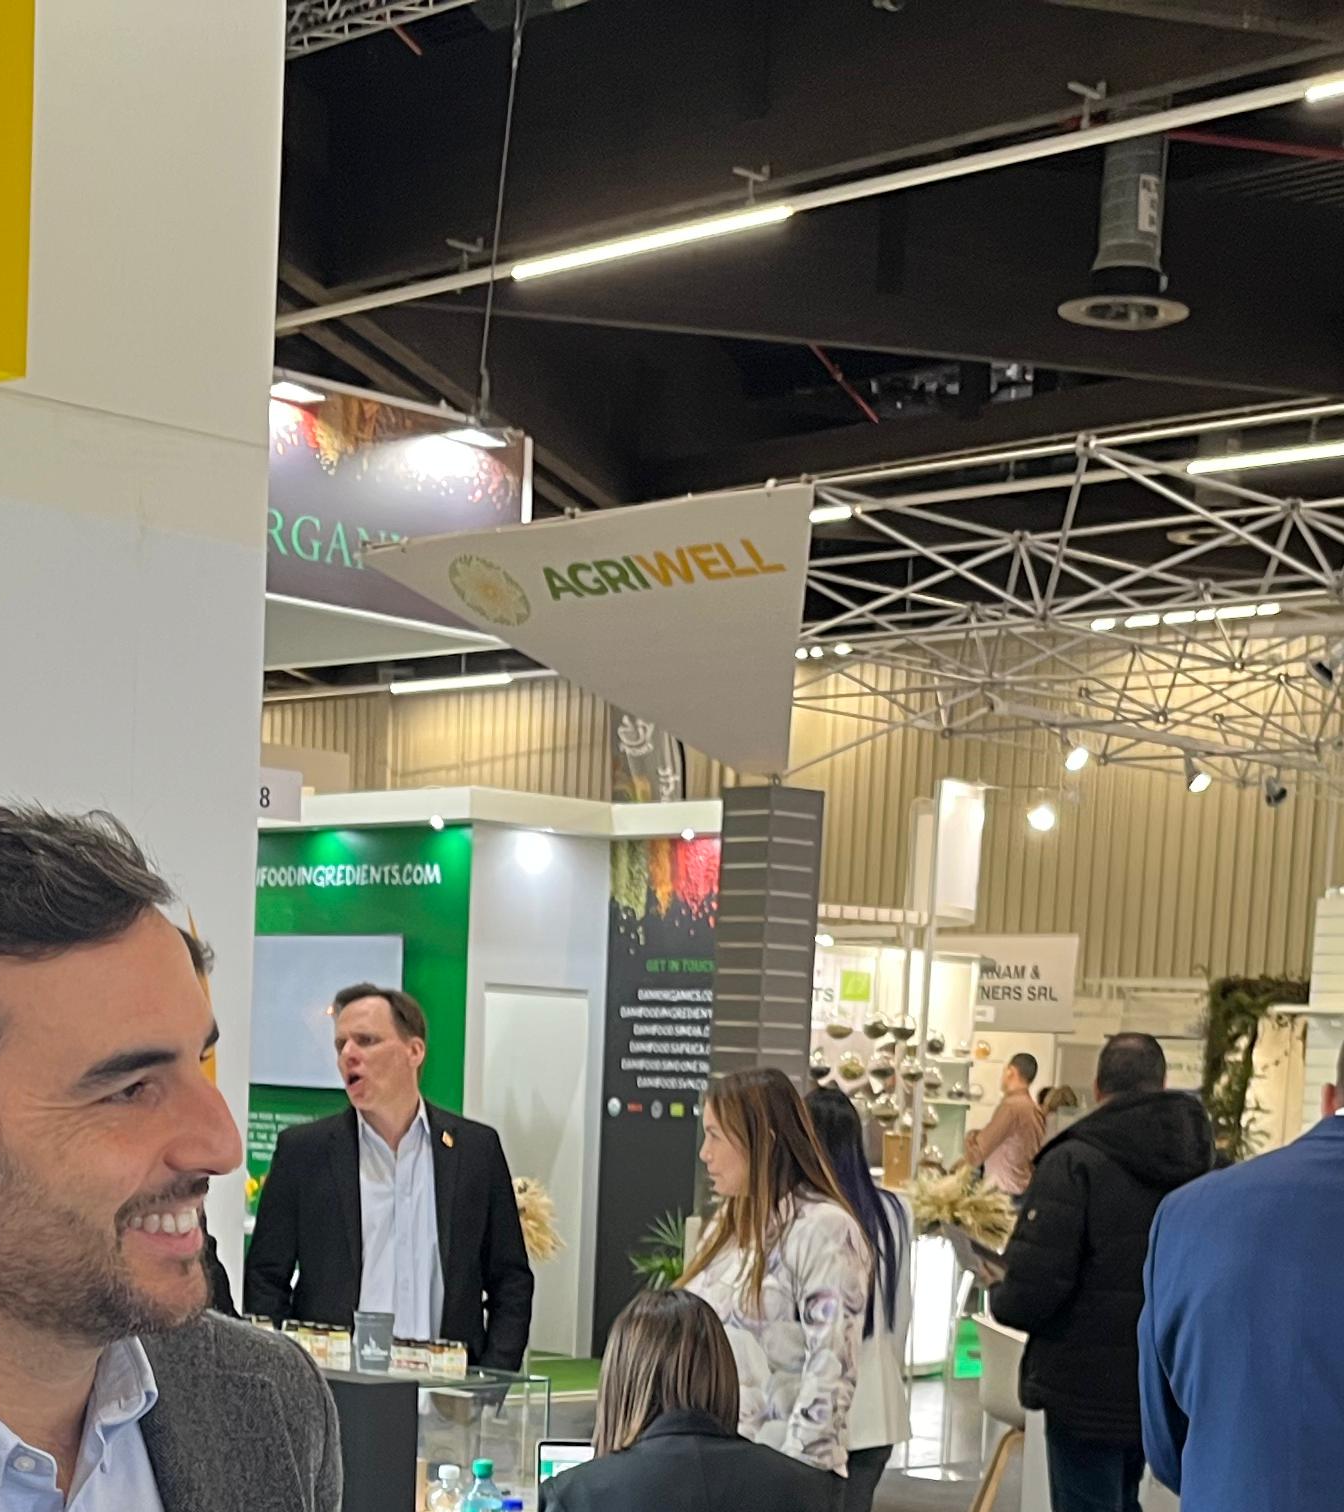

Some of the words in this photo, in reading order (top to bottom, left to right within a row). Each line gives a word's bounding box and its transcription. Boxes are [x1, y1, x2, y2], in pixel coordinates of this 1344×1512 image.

[542, 538, 787, 601] AGRIWELL
[1030, 964, 1040, 980] &
[1027, 986, 1058, 1002] SRL
